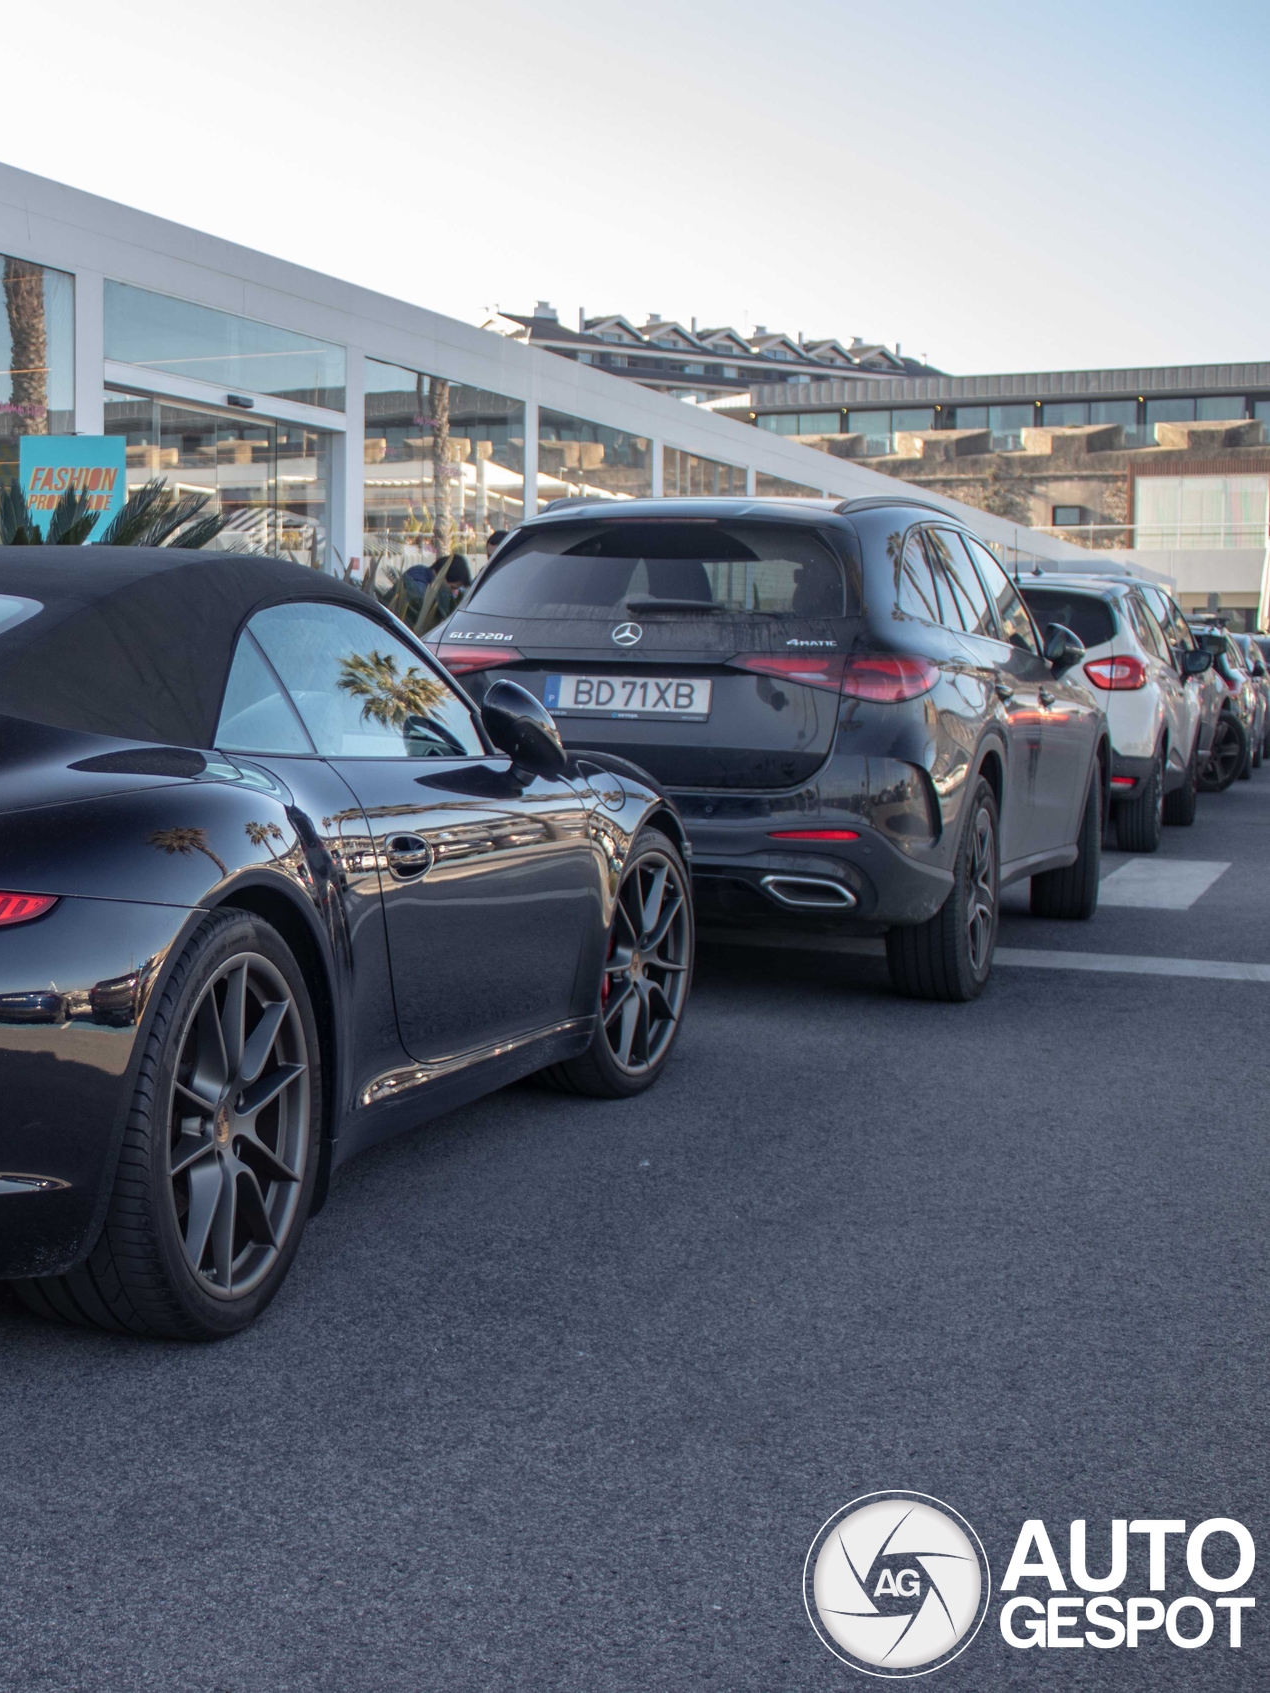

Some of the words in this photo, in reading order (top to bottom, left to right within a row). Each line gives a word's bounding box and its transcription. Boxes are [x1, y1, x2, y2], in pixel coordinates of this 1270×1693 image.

[29, 467, 118, 491] FASHION
[27, 494, 114, 511] PROADE
[450, 631, 475, 639] GLC
[476, 632, 514, 641] 220d
